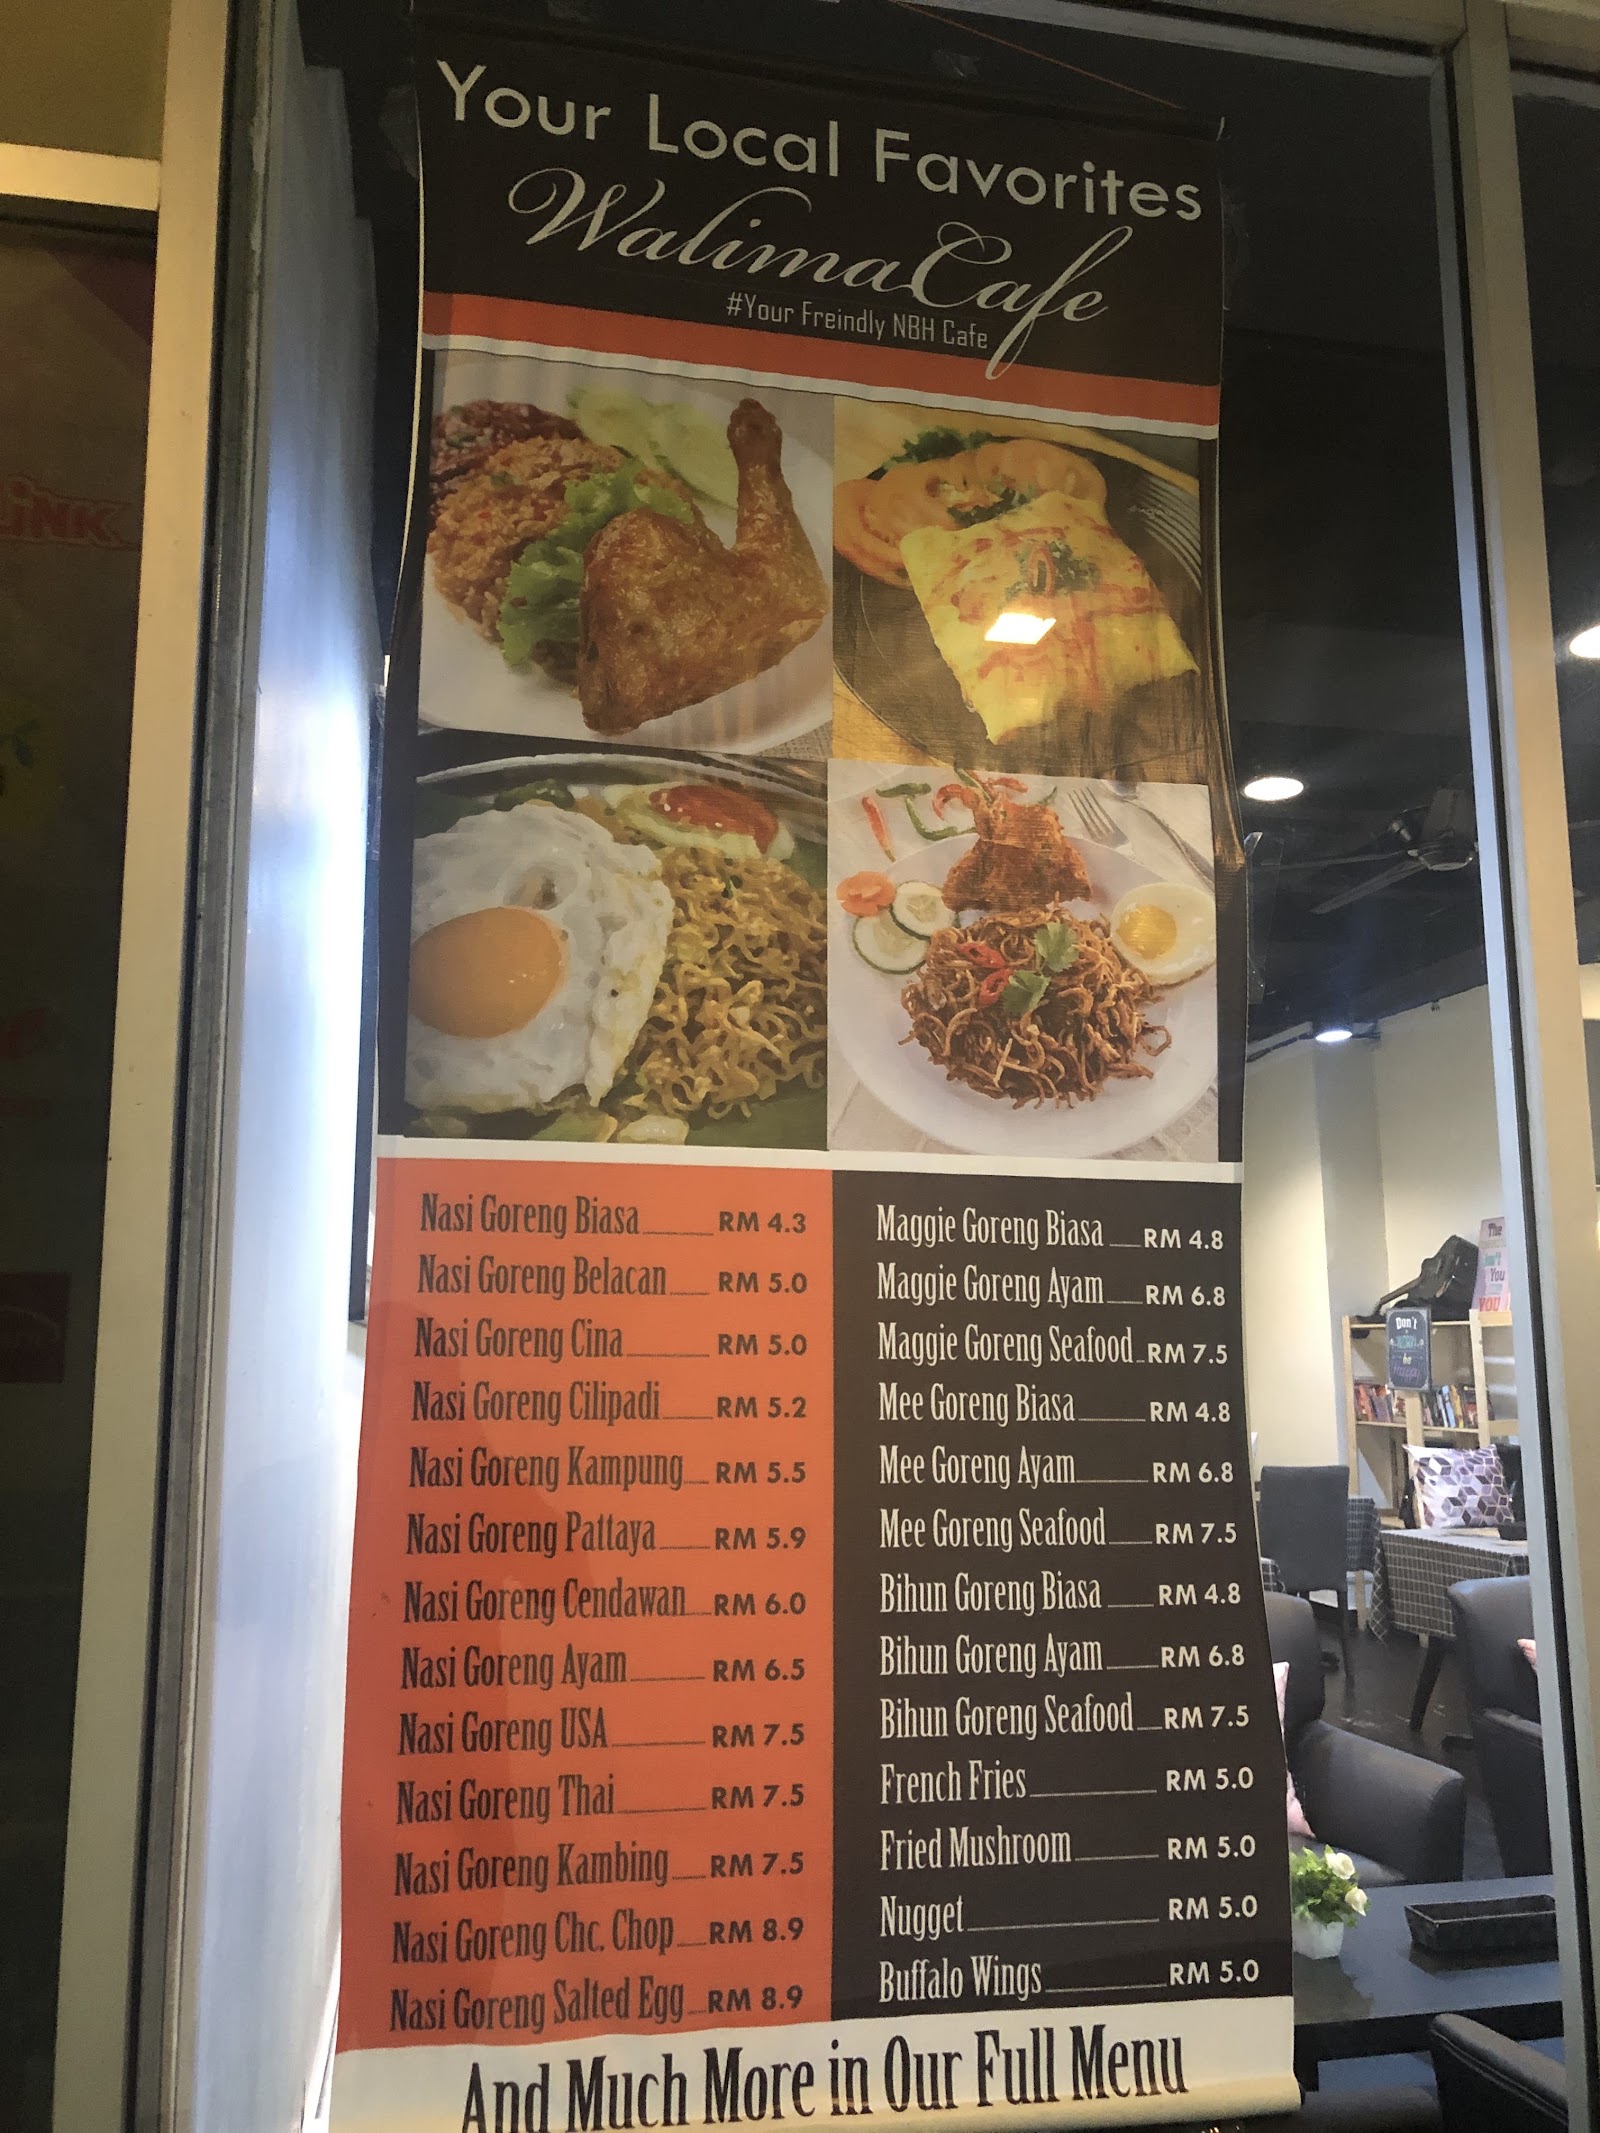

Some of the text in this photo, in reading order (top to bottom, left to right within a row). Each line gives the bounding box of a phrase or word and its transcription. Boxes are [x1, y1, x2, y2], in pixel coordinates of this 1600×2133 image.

[437, 60, 1201, 220] Your Local Favorites
[726, 293, 987, 348] #Your Freindly NBH Cafe
[421, 1193, 805, 1239] Nasi Goreng Biasa RM 4.3
[877, 1205, 1223, 1250] Maggie Goreng Biasa RM 4.8
[418, 1254, 807, 1300] Nasi Goreng Belacan RM 5.0
[878, 1262, 1225, 1308] Maggie Goreng Ayam RM 6.8
[414, 1317, 807, 1363] Nasi Goreng Cina RM 5.0
[878, 1322, 1227, 1367] Maggie Goreng Seafood RM 7.5
[412, 1381, 806, 1426] Nasi Goreng Cilipadi RM 5.2
[879, 1383, 1230, 1427] Mee Goreng Biasa RM 4.8
[409, 1446, 805, 1492] Nasi Goreng Kampung RM 5.5
[880, 1445, 1233, 1489] Mee Goreng Ayam RM 6.8
[407, 1511, 806, 1558] Nasi Goreng Pattaya RM 5.9
[880, 1507, 1236, 1552] Mee Goreng Seafood RM 7.5
[404, 1577, 805, 1626] Nasi Goreng Cendawan RM 6.0
[880, 1571, 1240, 1616] Bihun Goreng Biasa RM 4.8
[401, 1644, 804, 1690] Nasi Goreng Ayam RM 6.5
[881, 1633, 1244, 1678] Bihun Goreng Ayam RM 6.8
[398, 1707, 804, 1756] Nasi Goreng USA RM 7.5
[881, 1692, 1248, 1740] Bihun Goreng Seafood RM 7.5
[397, 1773, 804, 1824] Nasi Goreng Thai RM 7.5
[881, 1760, 1253, 1804] French Fries RM 5.0
[395, 1841, 803, 1896] Nasi Goreng Kambing RM 7.5
[881, 1825, 1255, 1870] Fried Mushroom RM 5.0
[393, 1908, 803, 1963] Nasi Goreng Chc. Chop RM 8.9
[881, 1895, 1257, 1941] Nugget RM 5.0
[880, 1955, 1259, 2002] Buffalo Wings RM 5.0
[390, 1976, 802, 2034] Nasi Goreng Salted Egg RM 8.9
[462, 2024, 1188, 2133] And Much More in Our Full Menu
